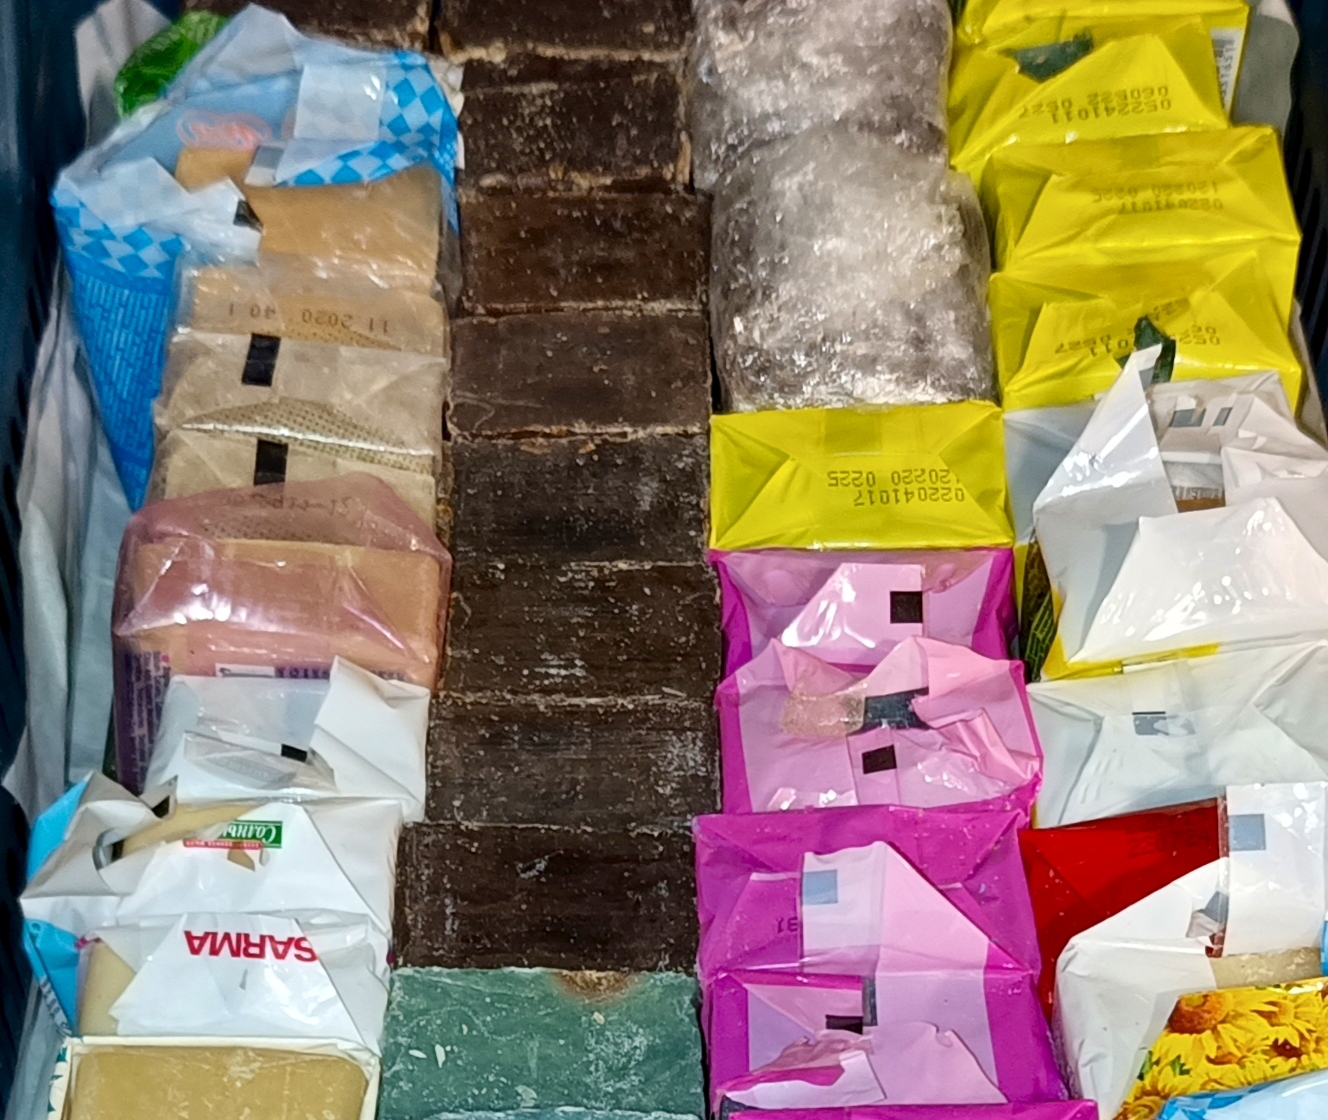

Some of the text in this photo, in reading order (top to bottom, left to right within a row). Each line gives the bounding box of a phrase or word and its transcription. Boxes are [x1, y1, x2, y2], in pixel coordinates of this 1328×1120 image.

[827, 470, 876, 488] 0225
[853, 486, 966, 507] 022041017
[183, 930, 320, 962] SARMA
